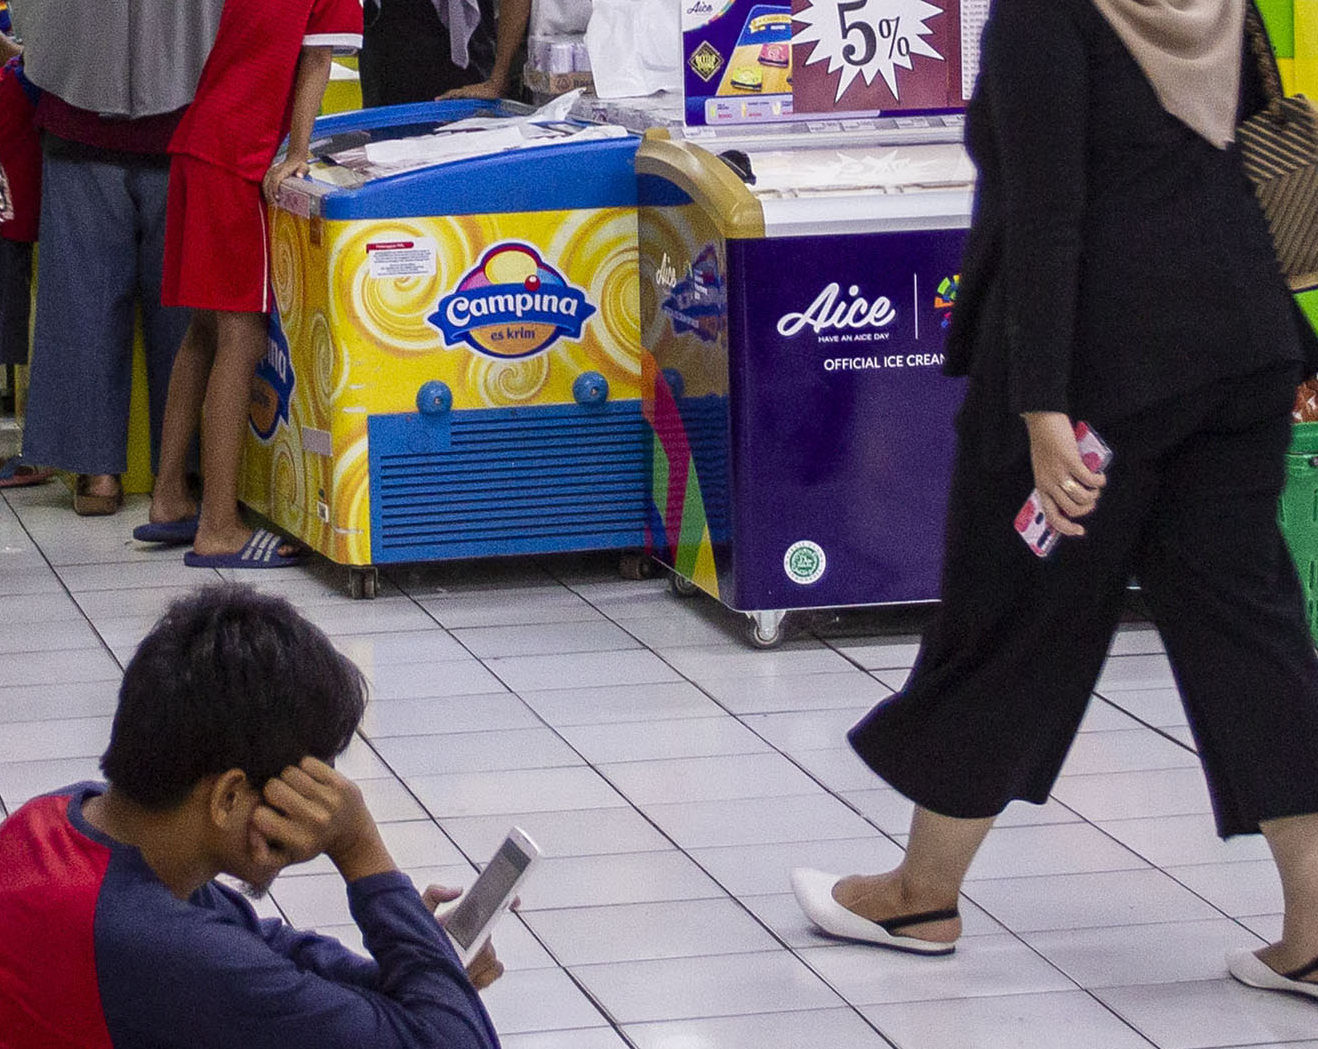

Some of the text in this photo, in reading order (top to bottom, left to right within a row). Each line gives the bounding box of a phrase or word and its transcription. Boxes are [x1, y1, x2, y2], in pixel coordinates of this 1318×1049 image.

[686, 1, 713, 15] Aice
[446, 293, 578, 327] Campina
[776, 282, 897, 337] Aice
[491, 327, 536, 341] es krim
[818, 332, 890, 344] HAVE AN AICE DAY
[824, 357, 881, 371] OFFICIAL
[884, 355, 904, 368] ICE
